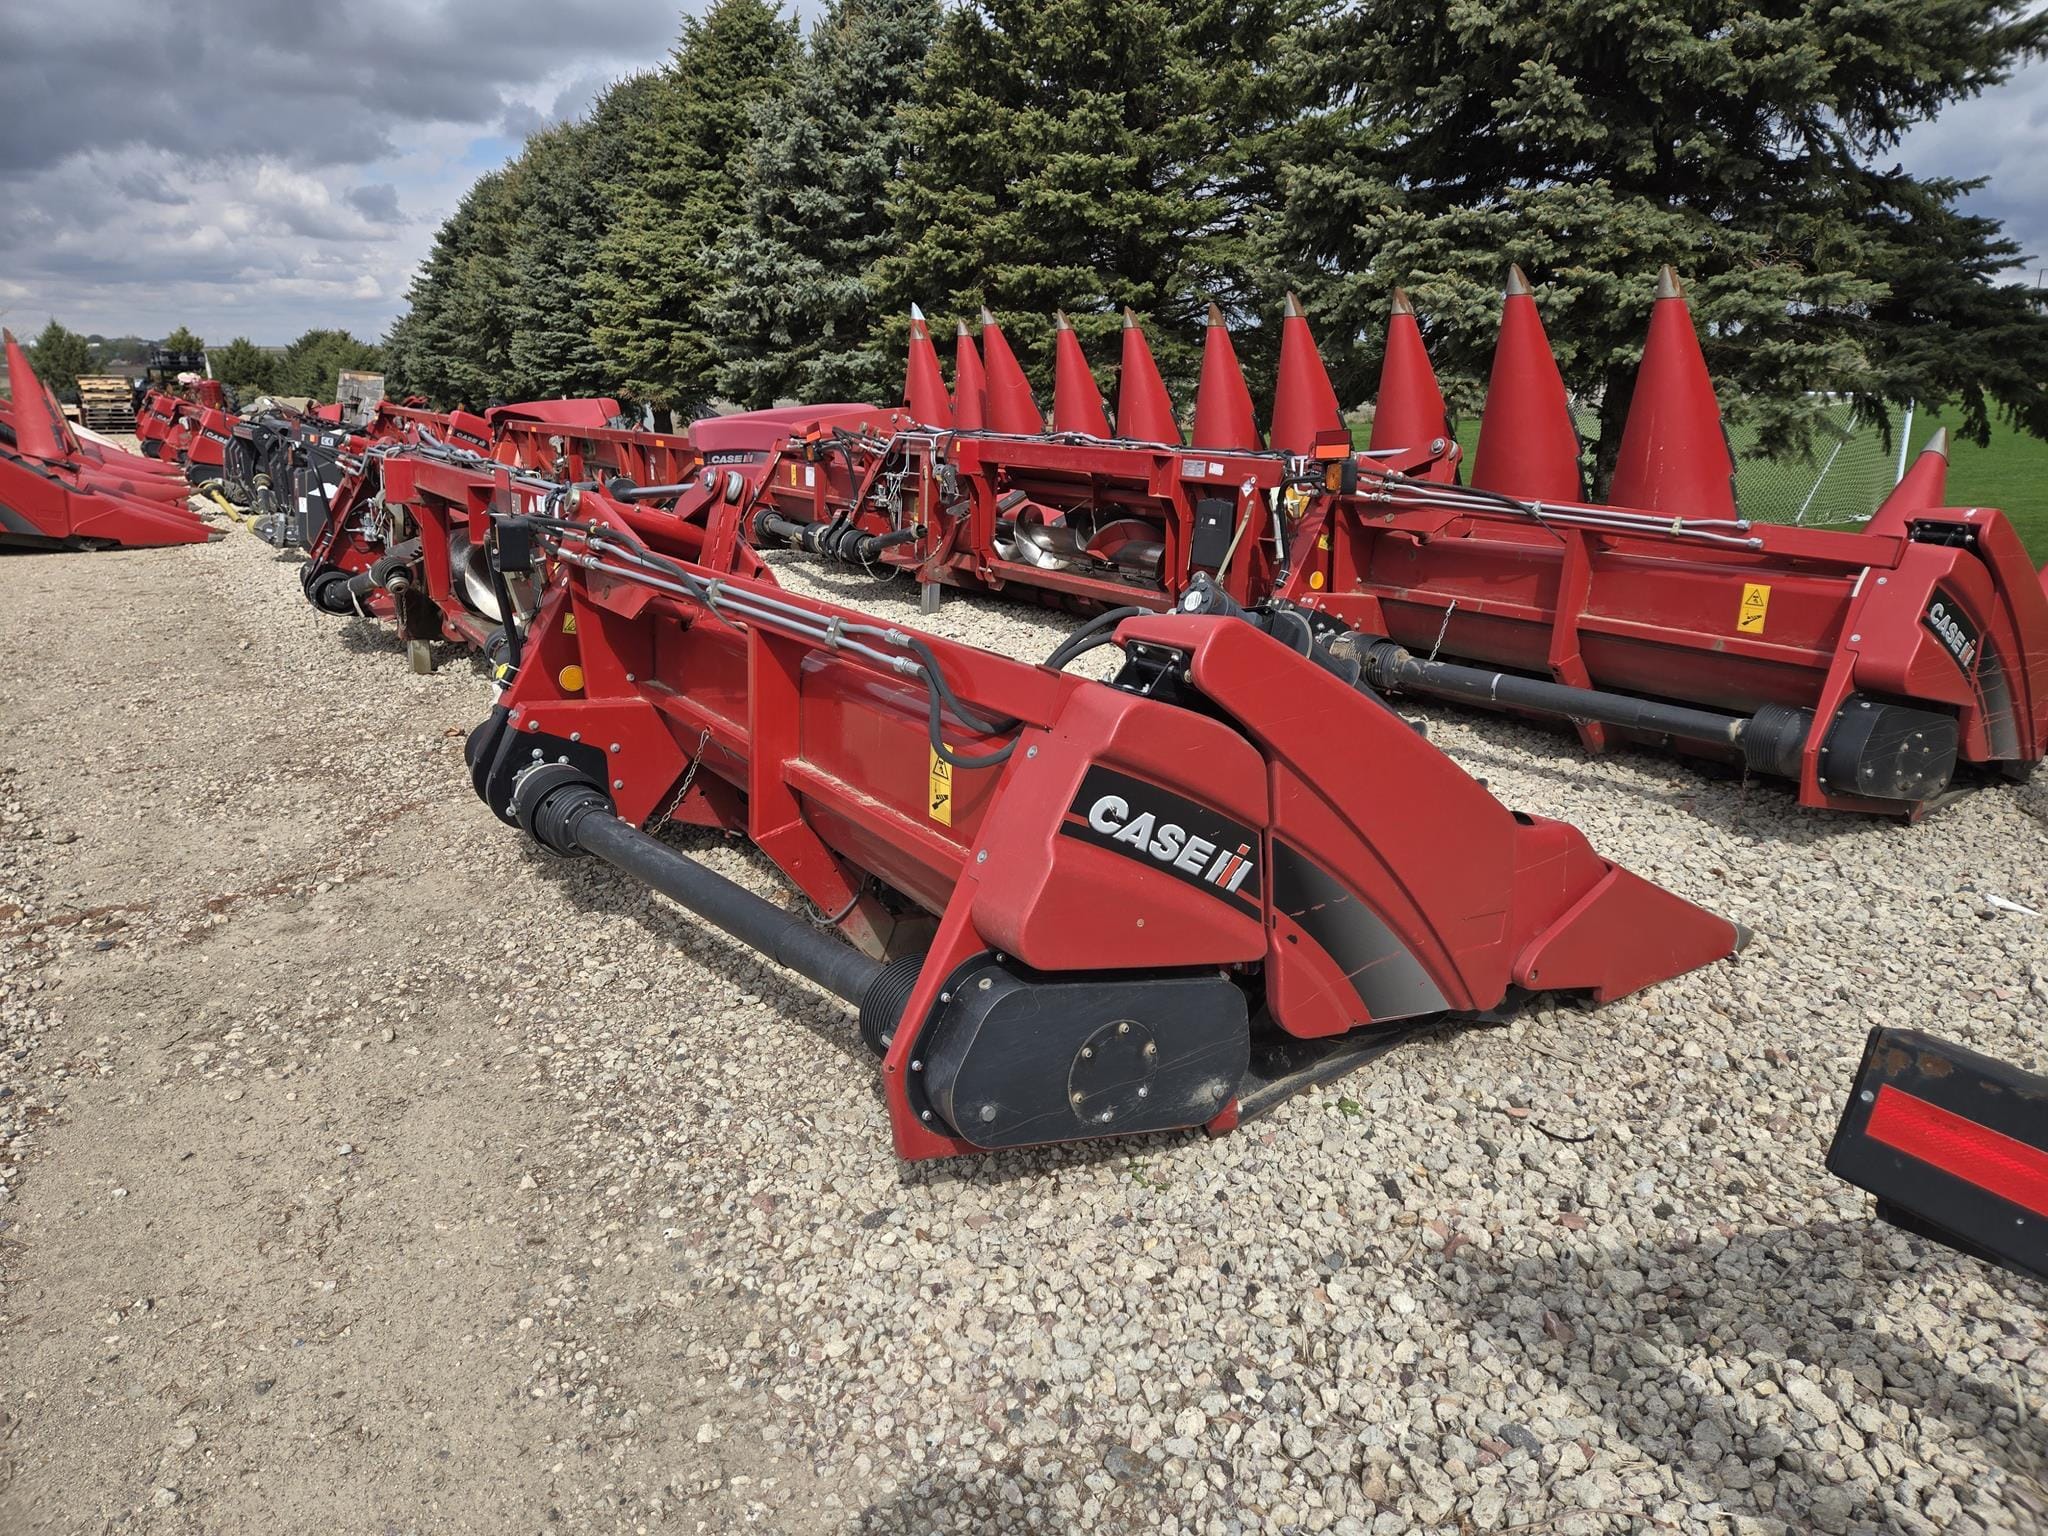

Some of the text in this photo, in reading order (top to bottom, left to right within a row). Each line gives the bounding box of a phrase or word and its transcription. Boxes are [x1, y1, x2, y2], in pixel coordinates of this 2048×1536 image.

[456, 432, 478, 444] CASE
[711, 454, 743, 464] CASE
[1930, 602, 1966, 655] CASE
[1089, 795, 1217, 877] CASE
